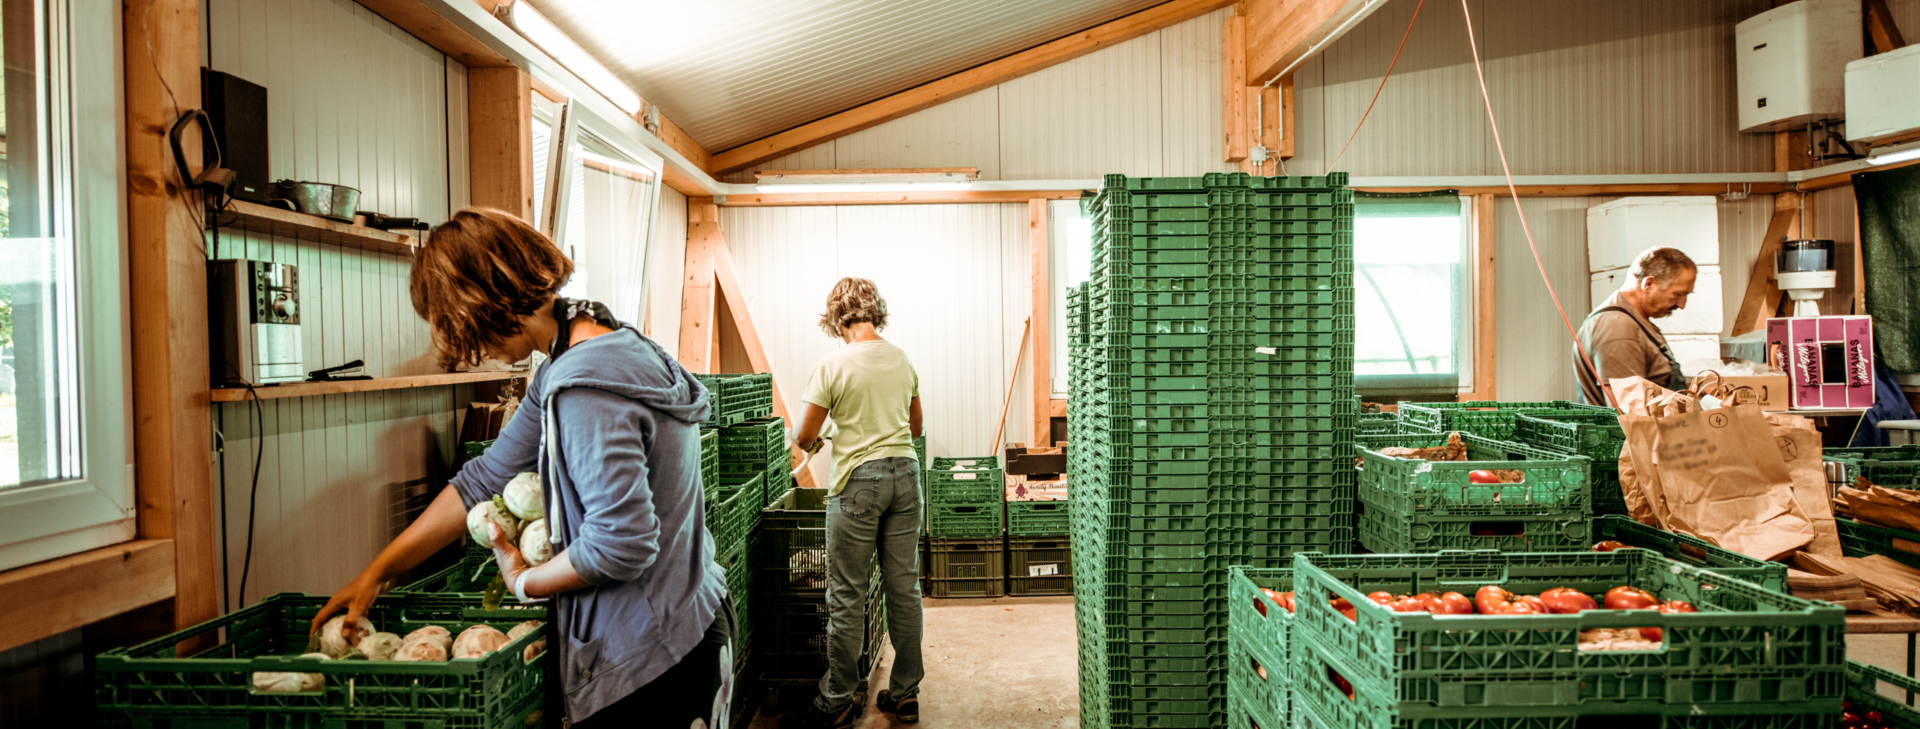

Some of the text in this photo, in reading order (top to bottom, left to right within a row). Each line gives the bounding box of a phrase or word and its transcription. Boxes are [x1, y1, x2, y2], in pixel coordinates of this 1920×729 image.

[1796, 343, 1810, 383] Milagros
[1805, 338, 1818, 387] BANANAS
[1850, 339, 1861, 388] BANANAS
[1856, 343, 1869, 384] Milagros
